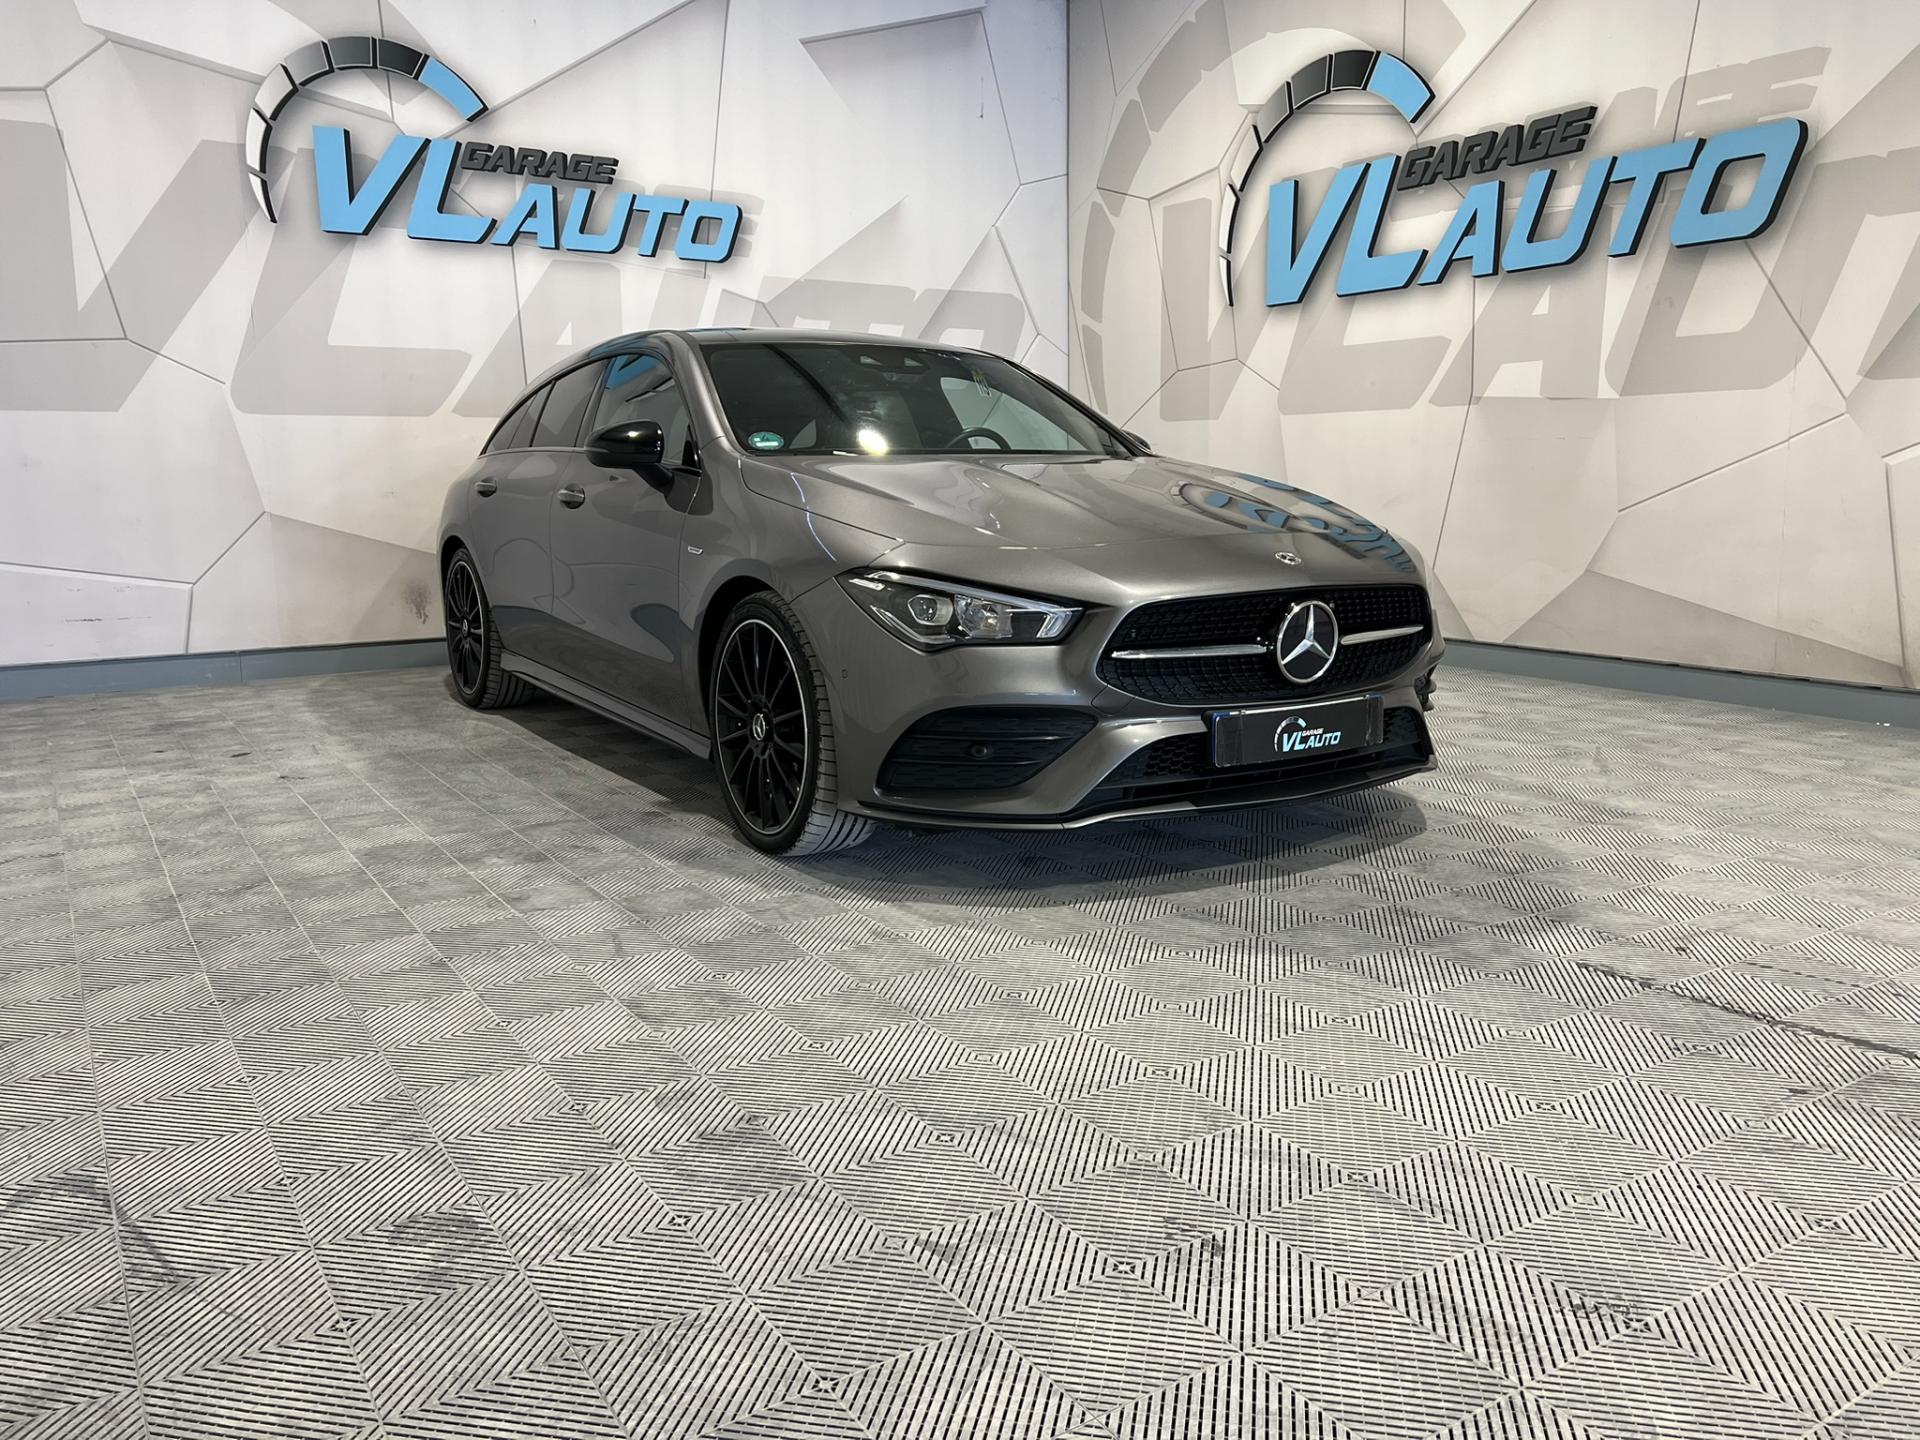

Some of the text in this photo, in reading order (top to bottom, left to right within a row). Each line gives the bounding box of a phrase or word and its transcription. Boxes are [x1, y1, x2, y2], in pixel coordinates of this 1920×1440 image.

[459, 140, 619, 185] GARAGE
[1396, 103, 1599, 191] GARAGE
[1301, 727, 1324, 737] GARAGE
